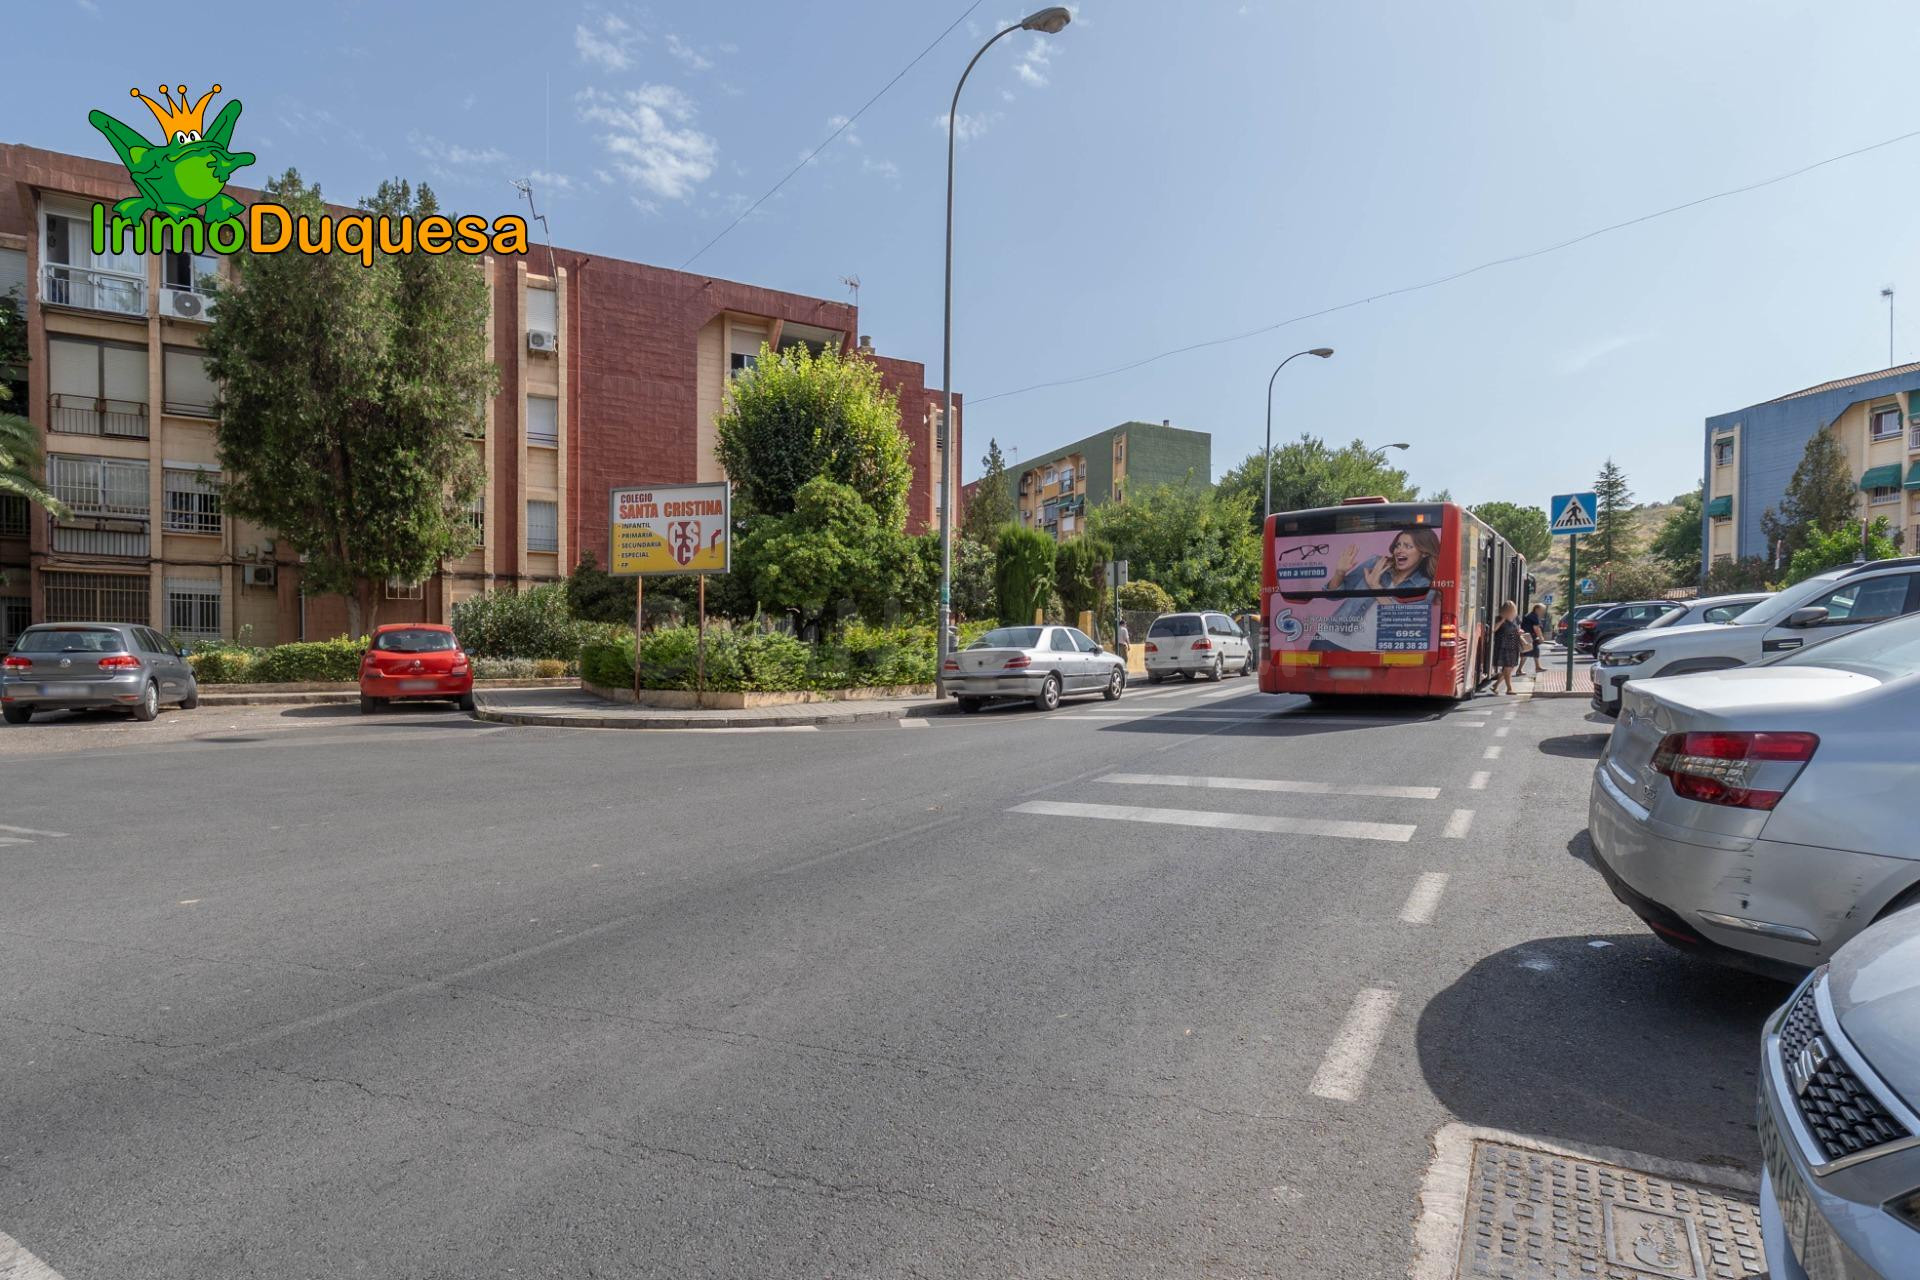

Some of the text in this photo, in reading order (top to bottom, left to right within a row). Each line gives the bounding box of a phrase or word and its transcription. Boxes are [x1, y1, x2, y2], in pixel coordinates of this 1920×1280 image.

[620, 493, 653, 504] COLEGIO
[619, 500, 723, 519] SANTA CRISTINA
[1300, 569, 1325, 577] vernos
[1396, 630, 1421, 638] 695€
[1394, 642, 1405, 650] 28
[1417, 641, 1428, 650] 28
